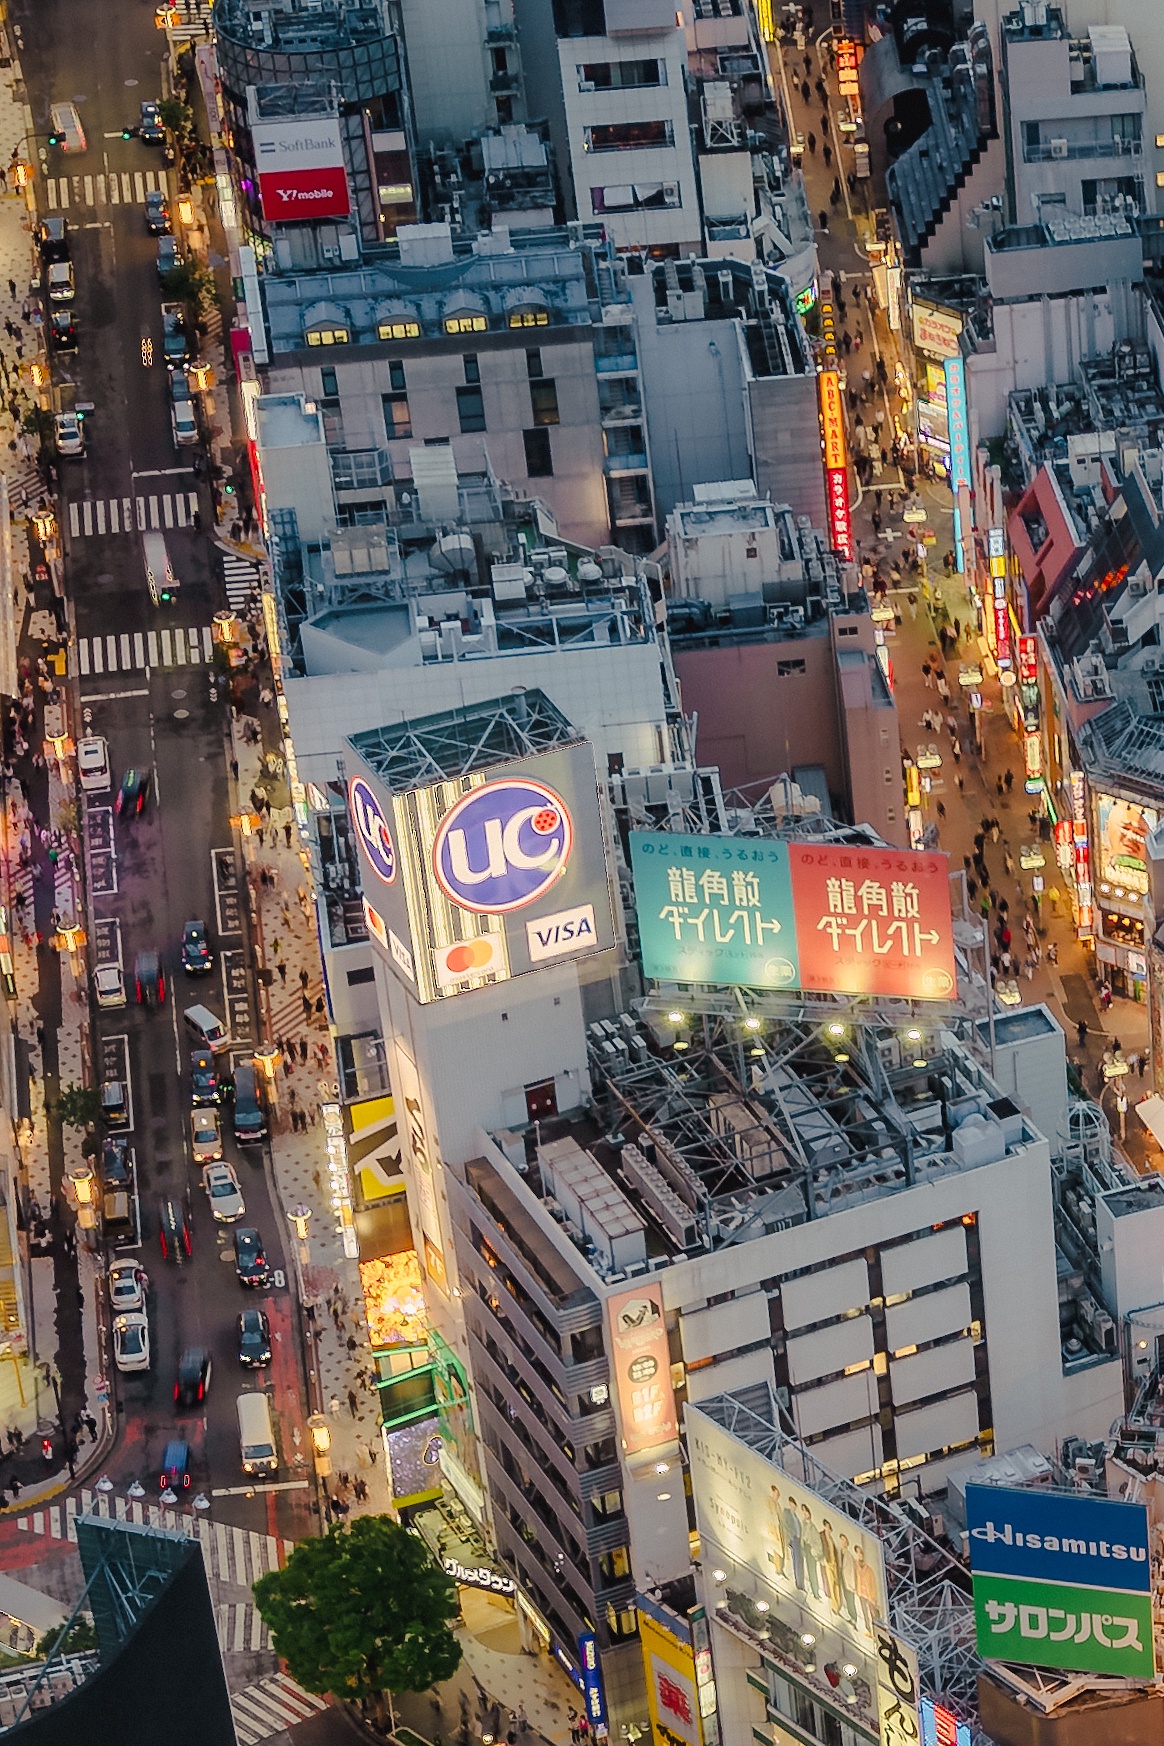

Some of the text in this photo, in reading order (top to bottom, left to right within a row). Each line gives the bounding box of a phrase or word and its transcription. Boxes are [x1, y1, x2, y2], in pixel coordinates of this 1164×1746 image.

[279, 138, 335, 152] SoftBank
[276, 189, 333, 201] Y!mobile
[667, 866, 761, 908] 龍角散
[825, 876, 920, 919] 龍角散
[535, 917, 592, 947] VISA
[659, 905, 782, 946] ダイレクト
[817, 915, 940, 957] ダイレクト
[971, 1521, 1147, 1562] Hisamitsu
[444, 1558, 517, 1592] グルメタウン
[985, 1600, 1143, 1652] サロンパス
